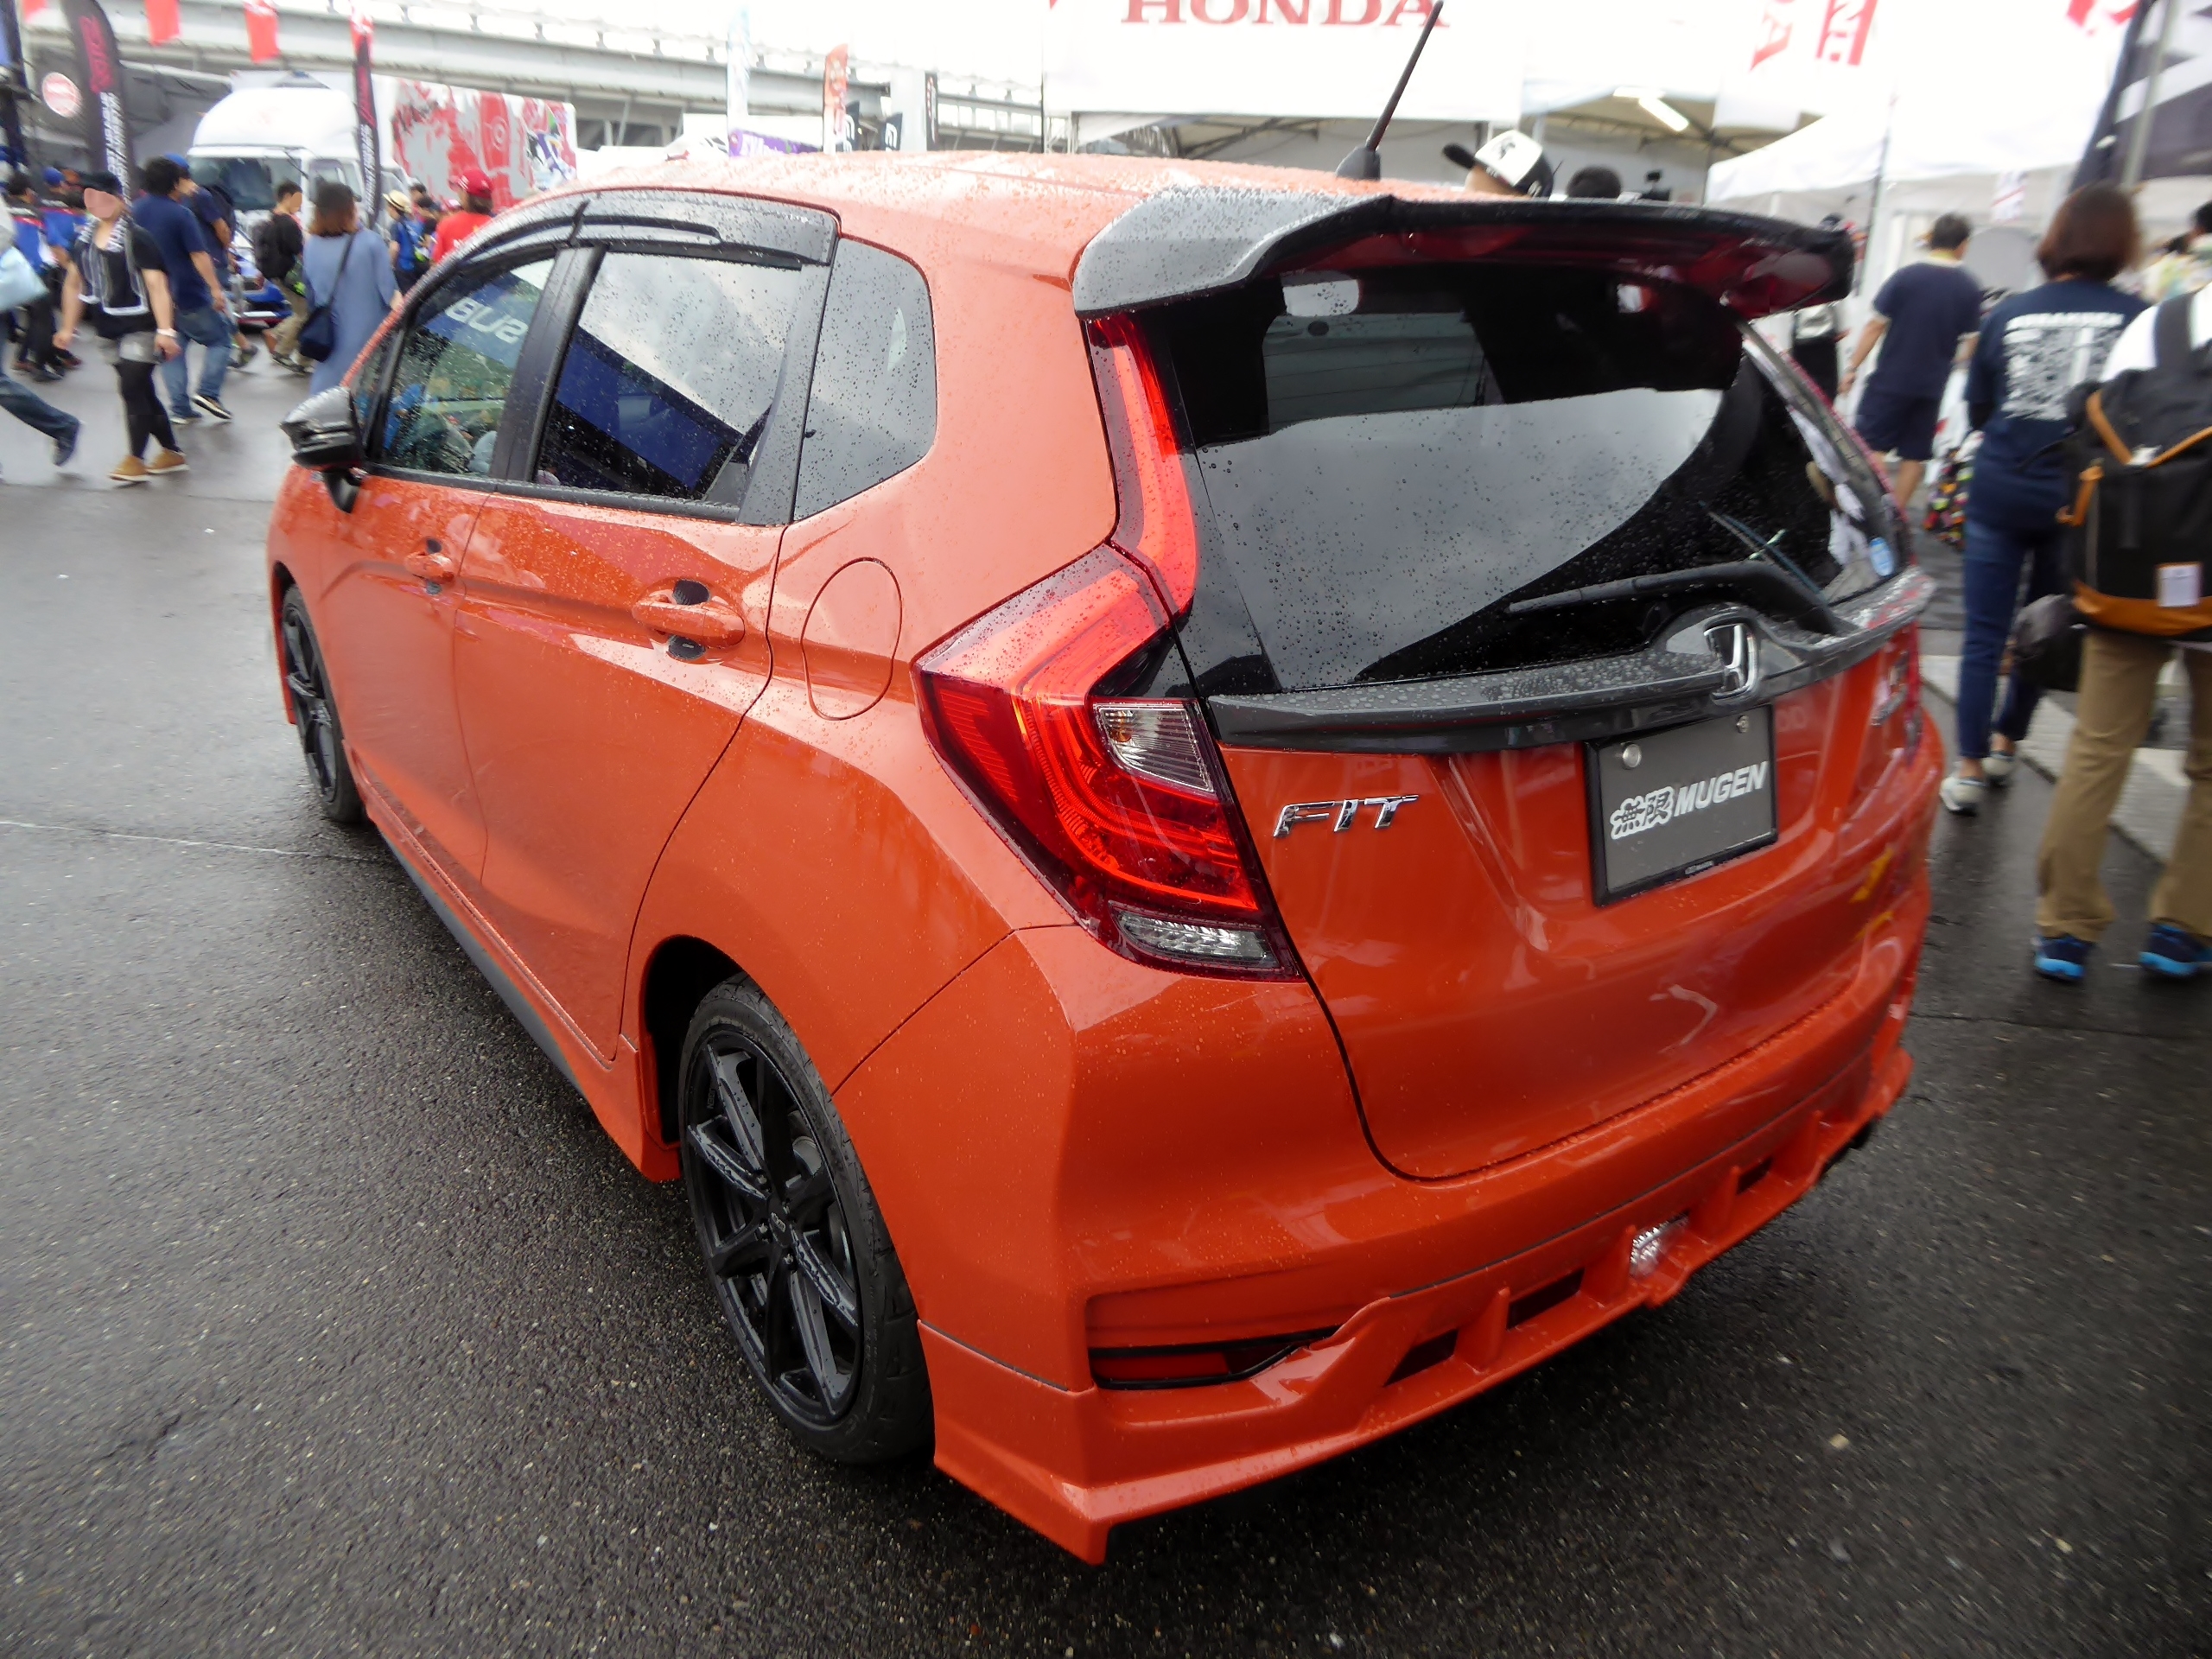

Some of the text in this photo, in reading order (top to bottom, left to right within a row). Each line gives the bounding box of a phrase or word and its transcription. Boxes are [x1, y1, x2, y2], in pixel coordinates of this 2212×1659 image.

[1121, 0, 1450, 28] HONDA
[1674, 760, 1770, 817] MUGEN
[1274, 794, 1419, 838] FIT
